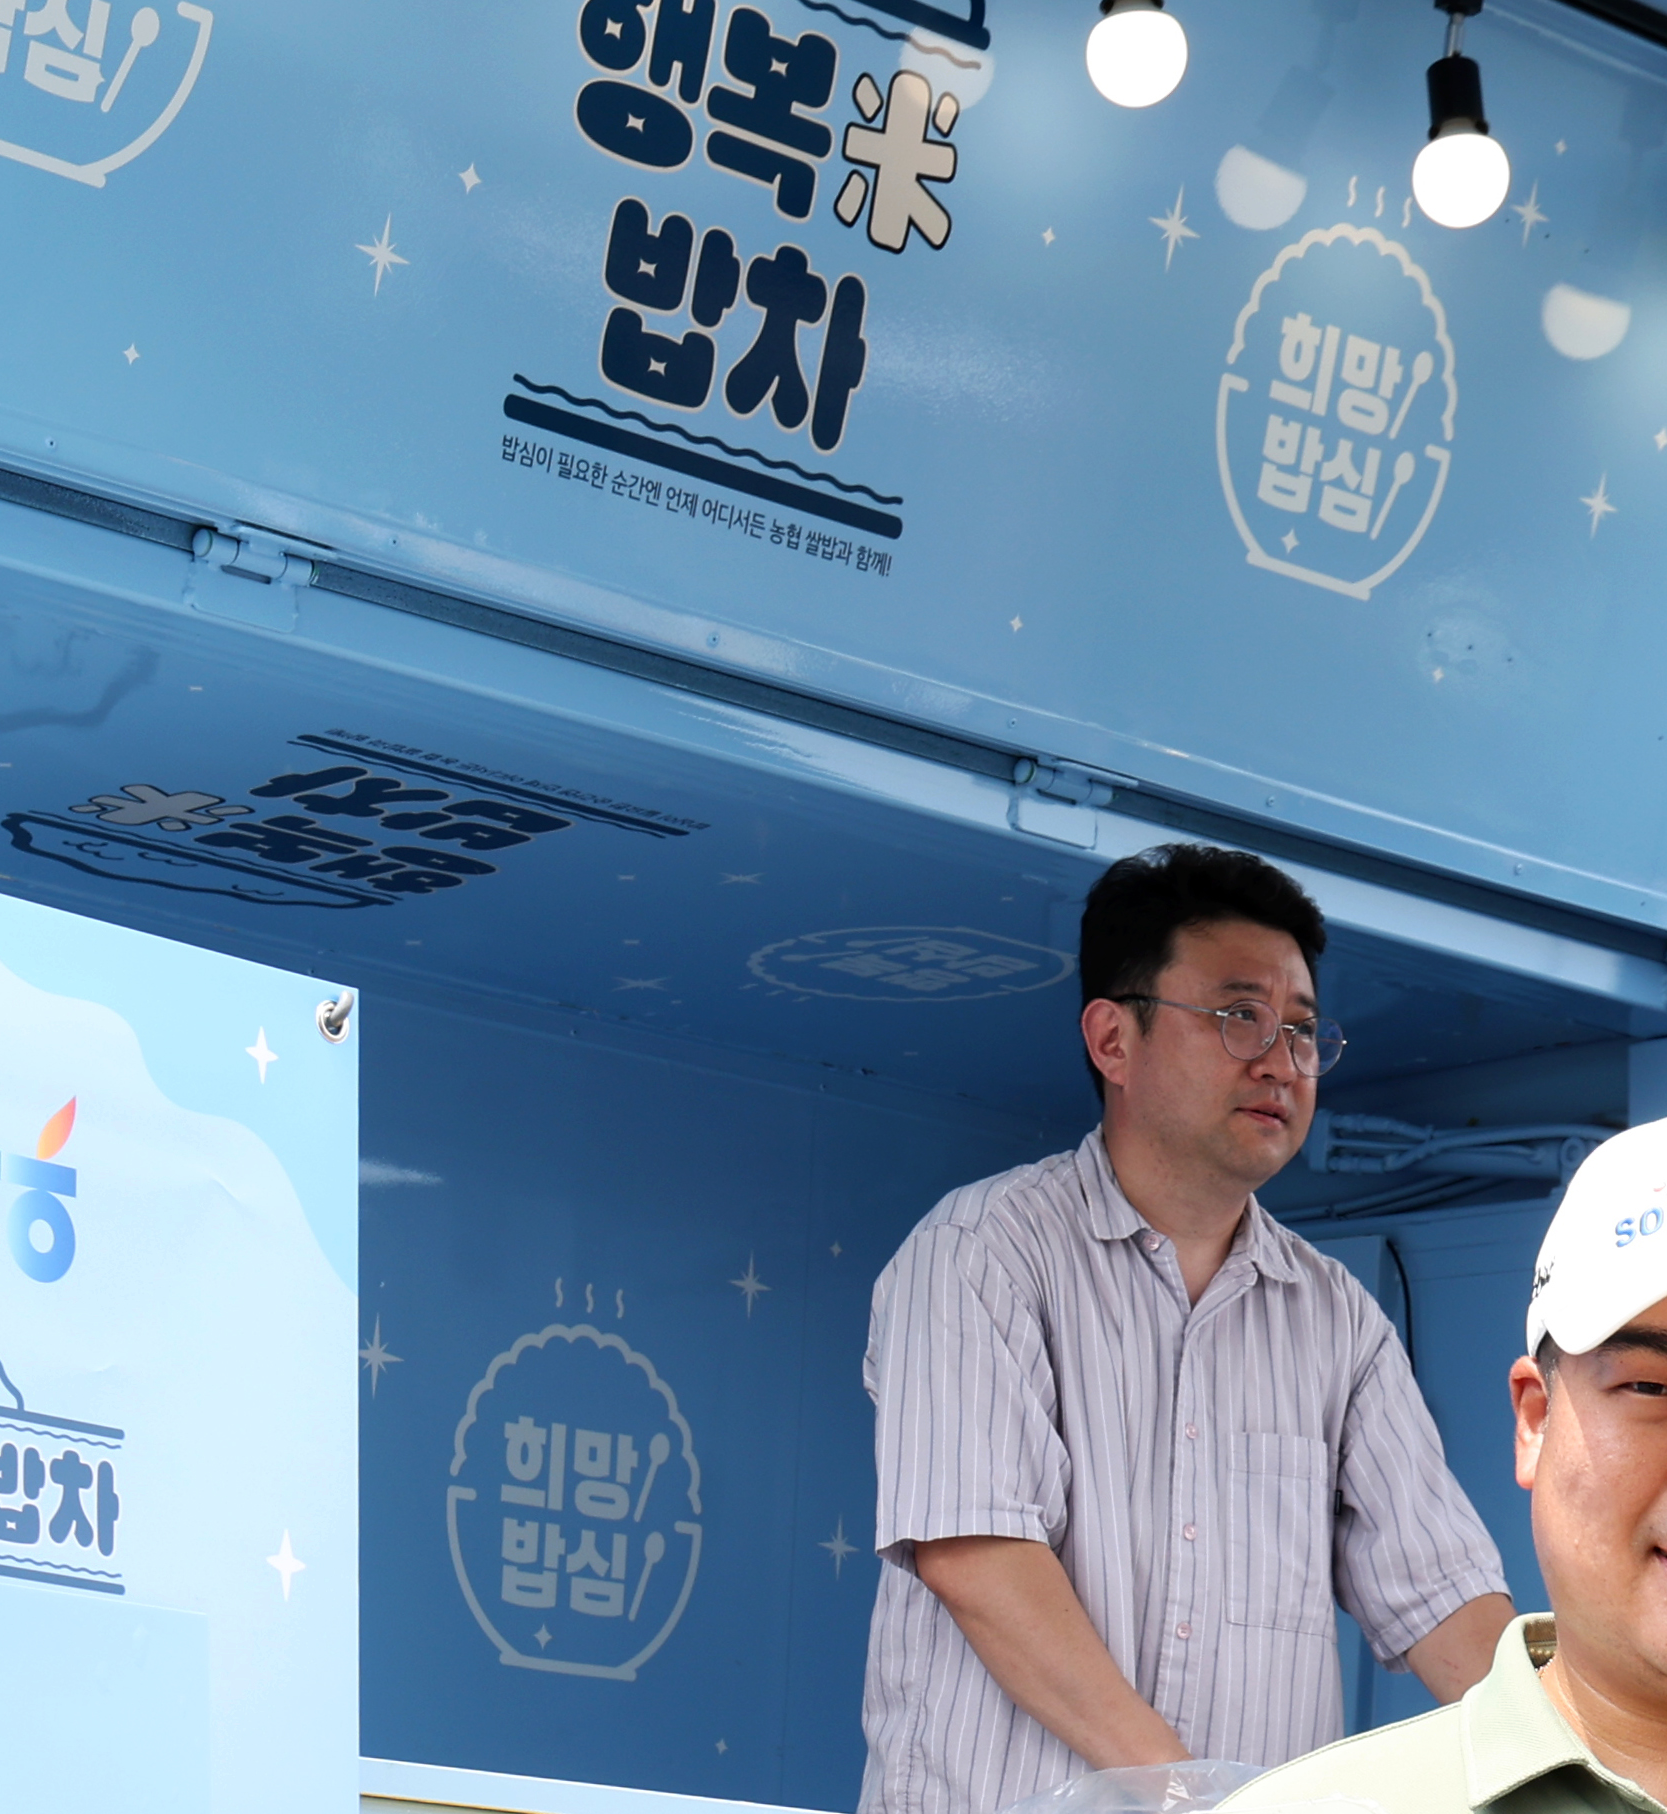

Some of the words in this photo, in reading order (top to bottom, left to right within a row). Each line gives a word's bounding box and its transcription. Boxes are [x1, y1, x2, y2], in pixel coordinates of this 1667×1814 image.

[598, 197, 868, 453] 밥차
[1269, 312, 1402, 436] 희망
[501, 434, 553, 474] 밥심이
[557, 452, 608, 490] 필요한
[611, 469, 662, 506] 순간엔
[665, 485, 698, 518] 언제
[702, 496, 766, 540] 어디서든
[769, 519, 802, 550] 농협
[805, 529, 853, 566] 쌀밥과
[856, 544, 892, 578] 함께!
[1257, 413, 1381, 535] 밥심
[501, 1416, 638, 1521] 희망
[501, 1516, 628, 1617] 밥심
